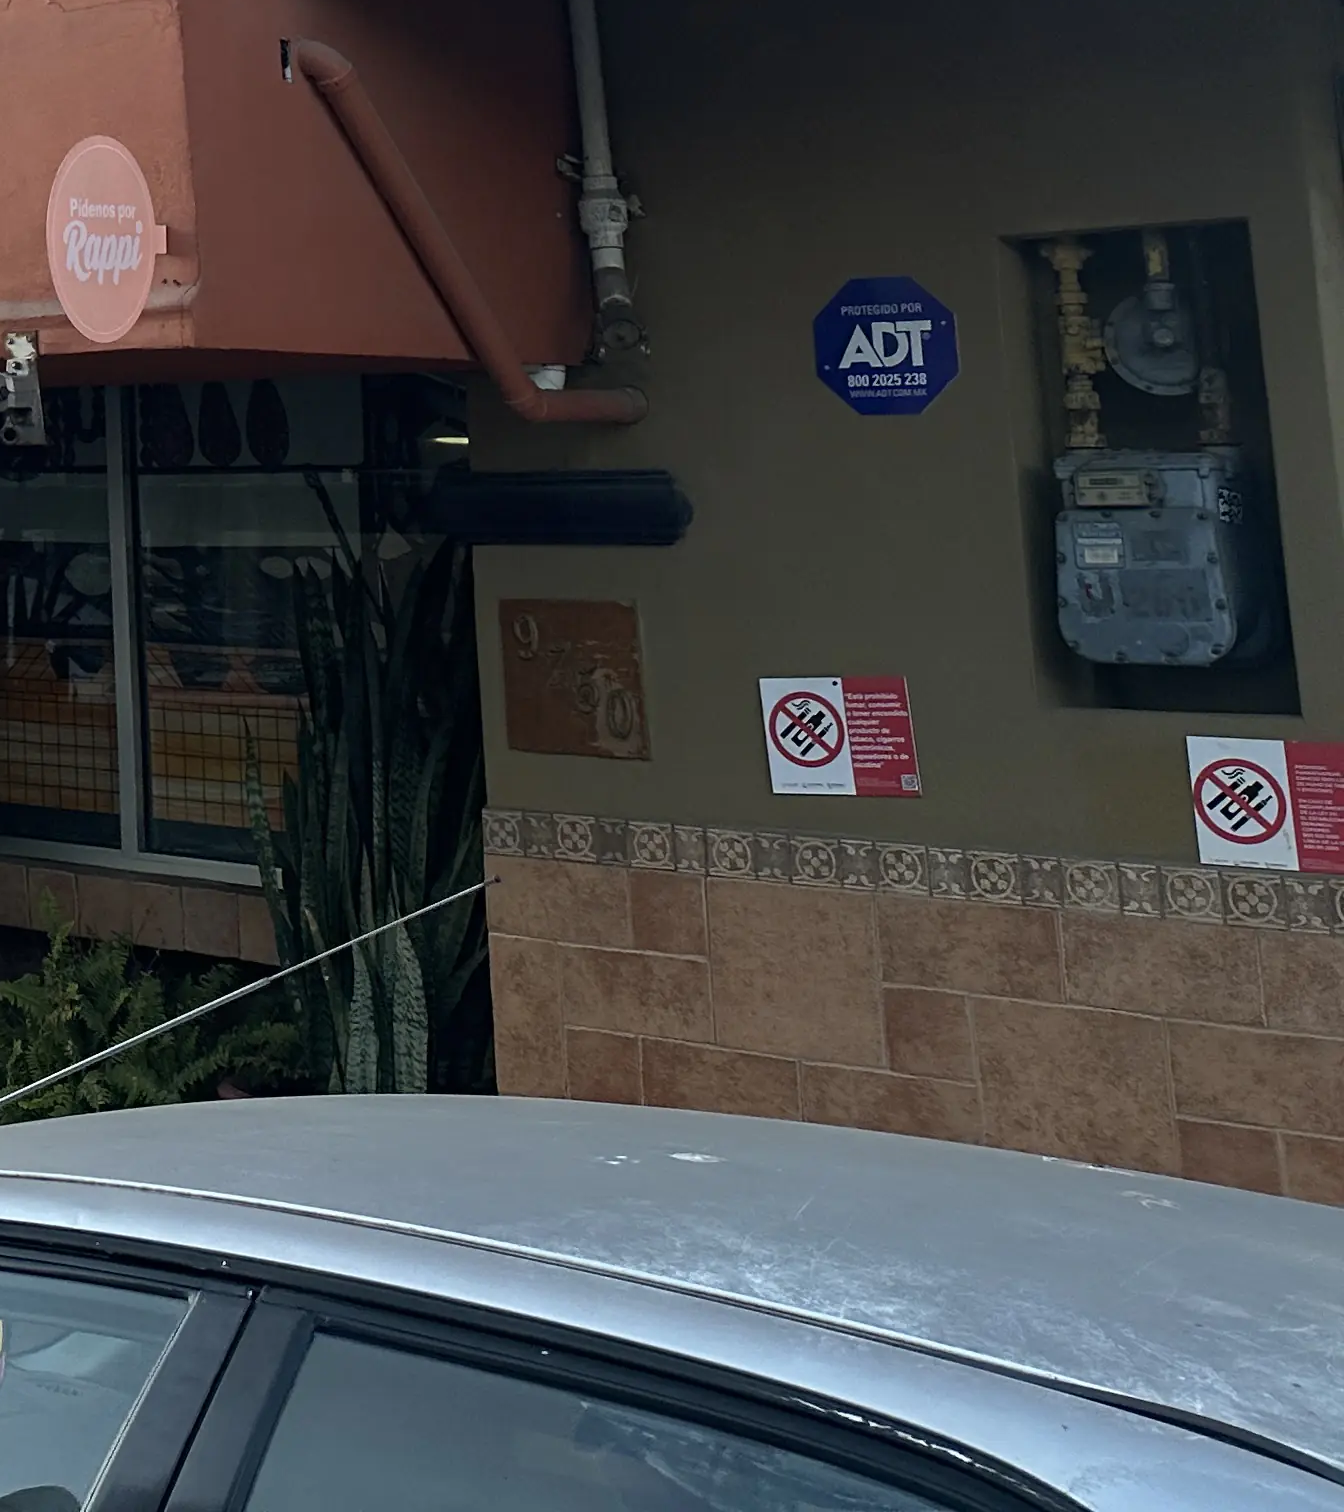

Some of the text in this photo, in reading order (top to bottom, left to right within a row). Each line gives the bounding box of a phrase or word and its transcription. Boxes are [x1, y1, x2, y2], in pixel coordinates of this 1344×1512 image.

[117, 203, 137, 225] por
[63, 220, 143, 286] Rappi
[840, 302, 923, 316] PROTEGIDO POR
[838, 319, 932, 369] ADT
[847, 372, 927, 387] 800 2025 238
